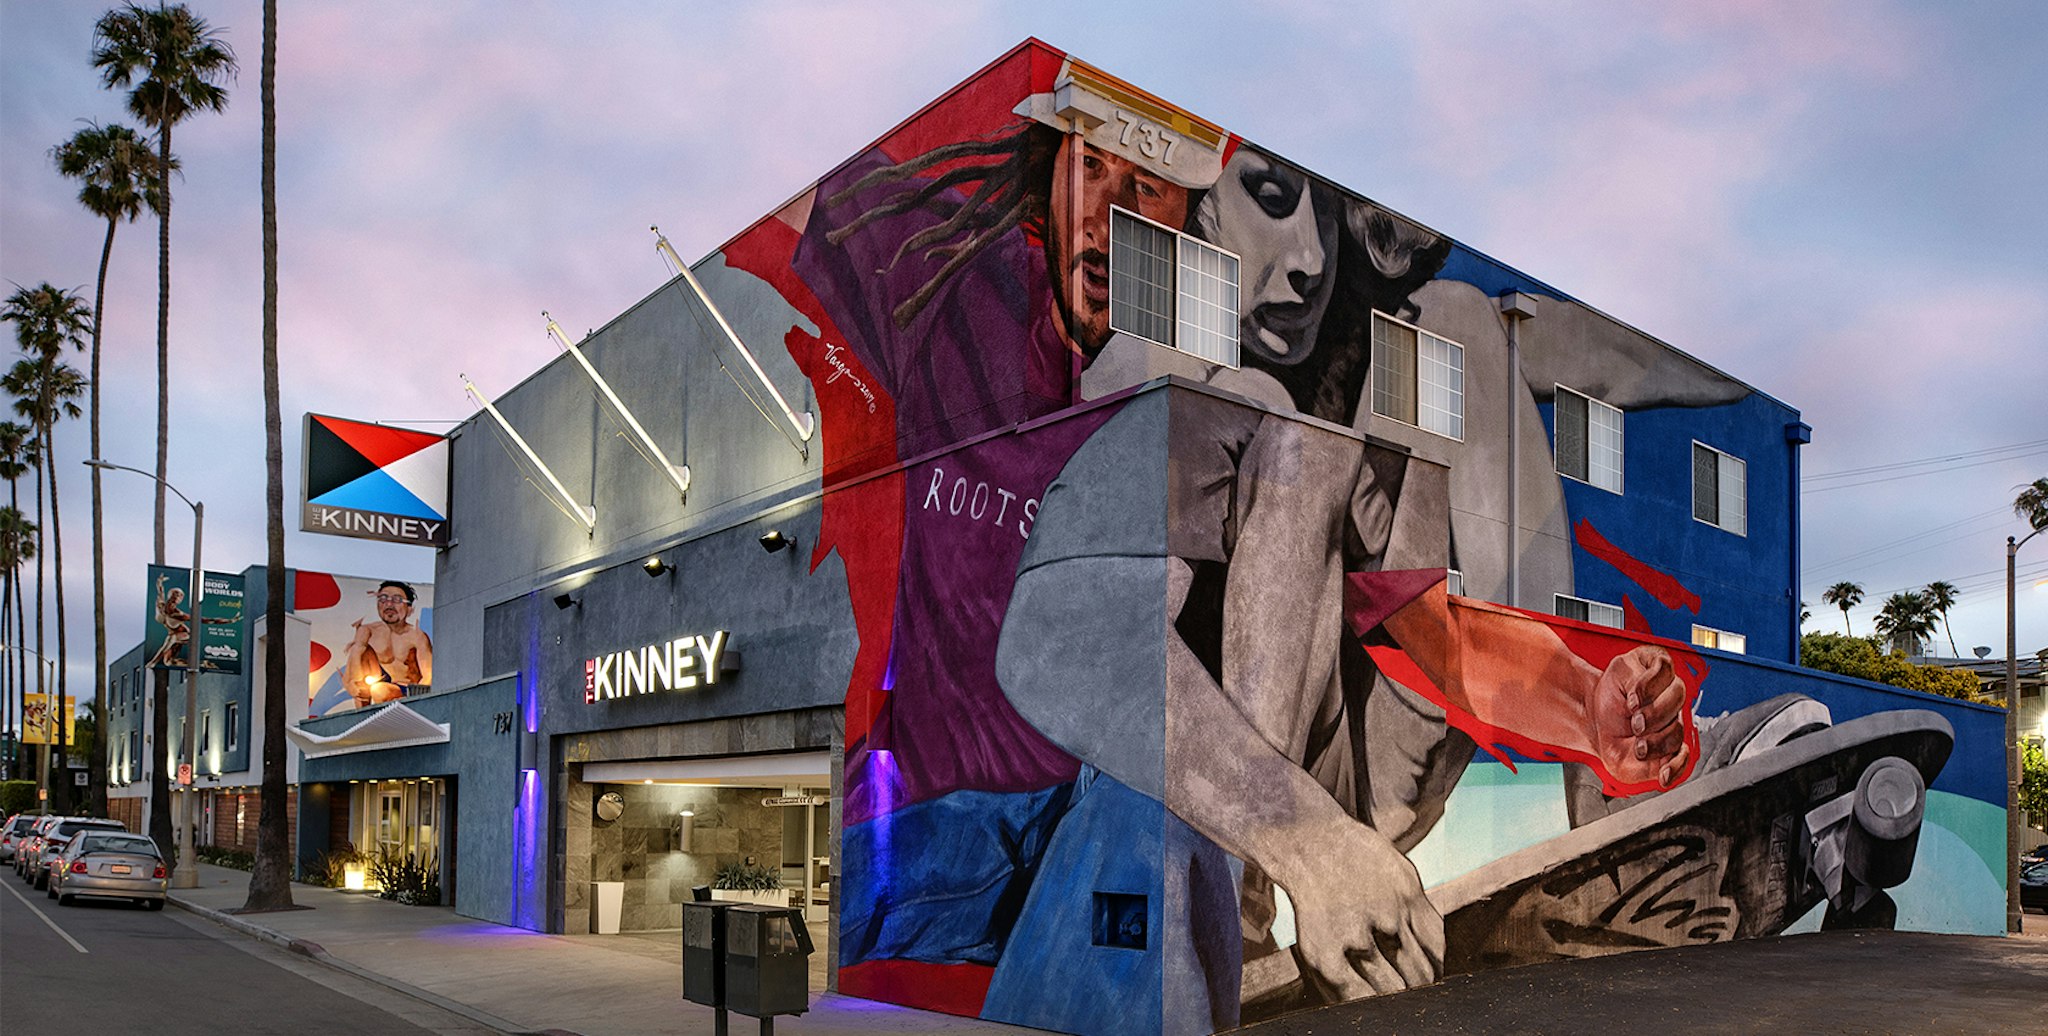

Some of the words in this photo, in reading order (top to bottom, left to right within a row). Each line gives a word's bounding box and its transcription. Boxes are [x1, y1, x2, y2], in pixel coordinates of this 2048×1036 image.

[1116, 110, 1180, 166] 737
[923, 468, 1040, 540] ROOTS
[311, 507, 321, 526] THE
[321, 508, 440, 540] KINNEY
[204, 581, 230, 590] BODY
[204, 588, 244, 597] WORLDS
[585, 659, 595, 704] THE
[594, 630, 730, 701] KINNEY
[493, 711, 513, 735] 737
